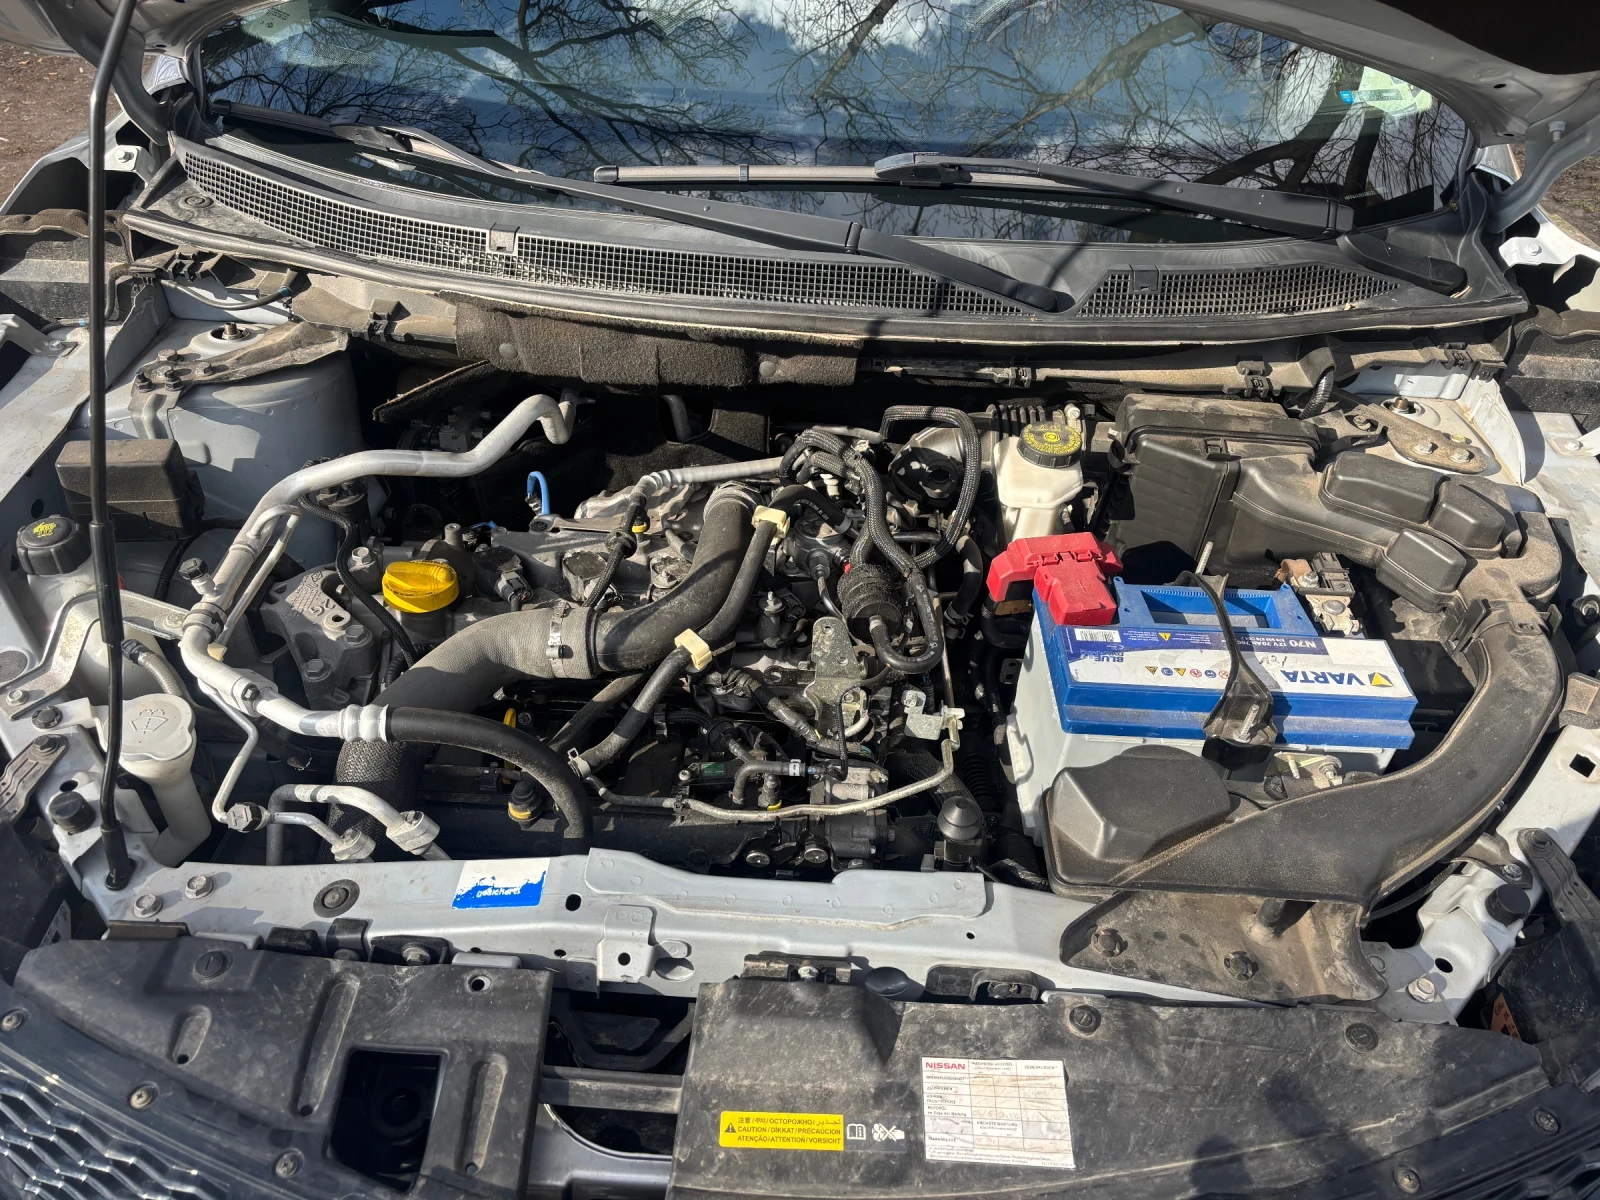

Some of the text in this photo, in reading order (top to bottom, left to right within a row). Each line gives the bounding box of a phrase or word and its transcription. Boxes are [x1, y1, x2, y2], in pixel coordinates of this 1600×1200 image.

[1289, 639, 1317, 649] N70
[1280, 670, 1365, 686] VARTA
[925, 1062, 965, 1070] NISSAN
